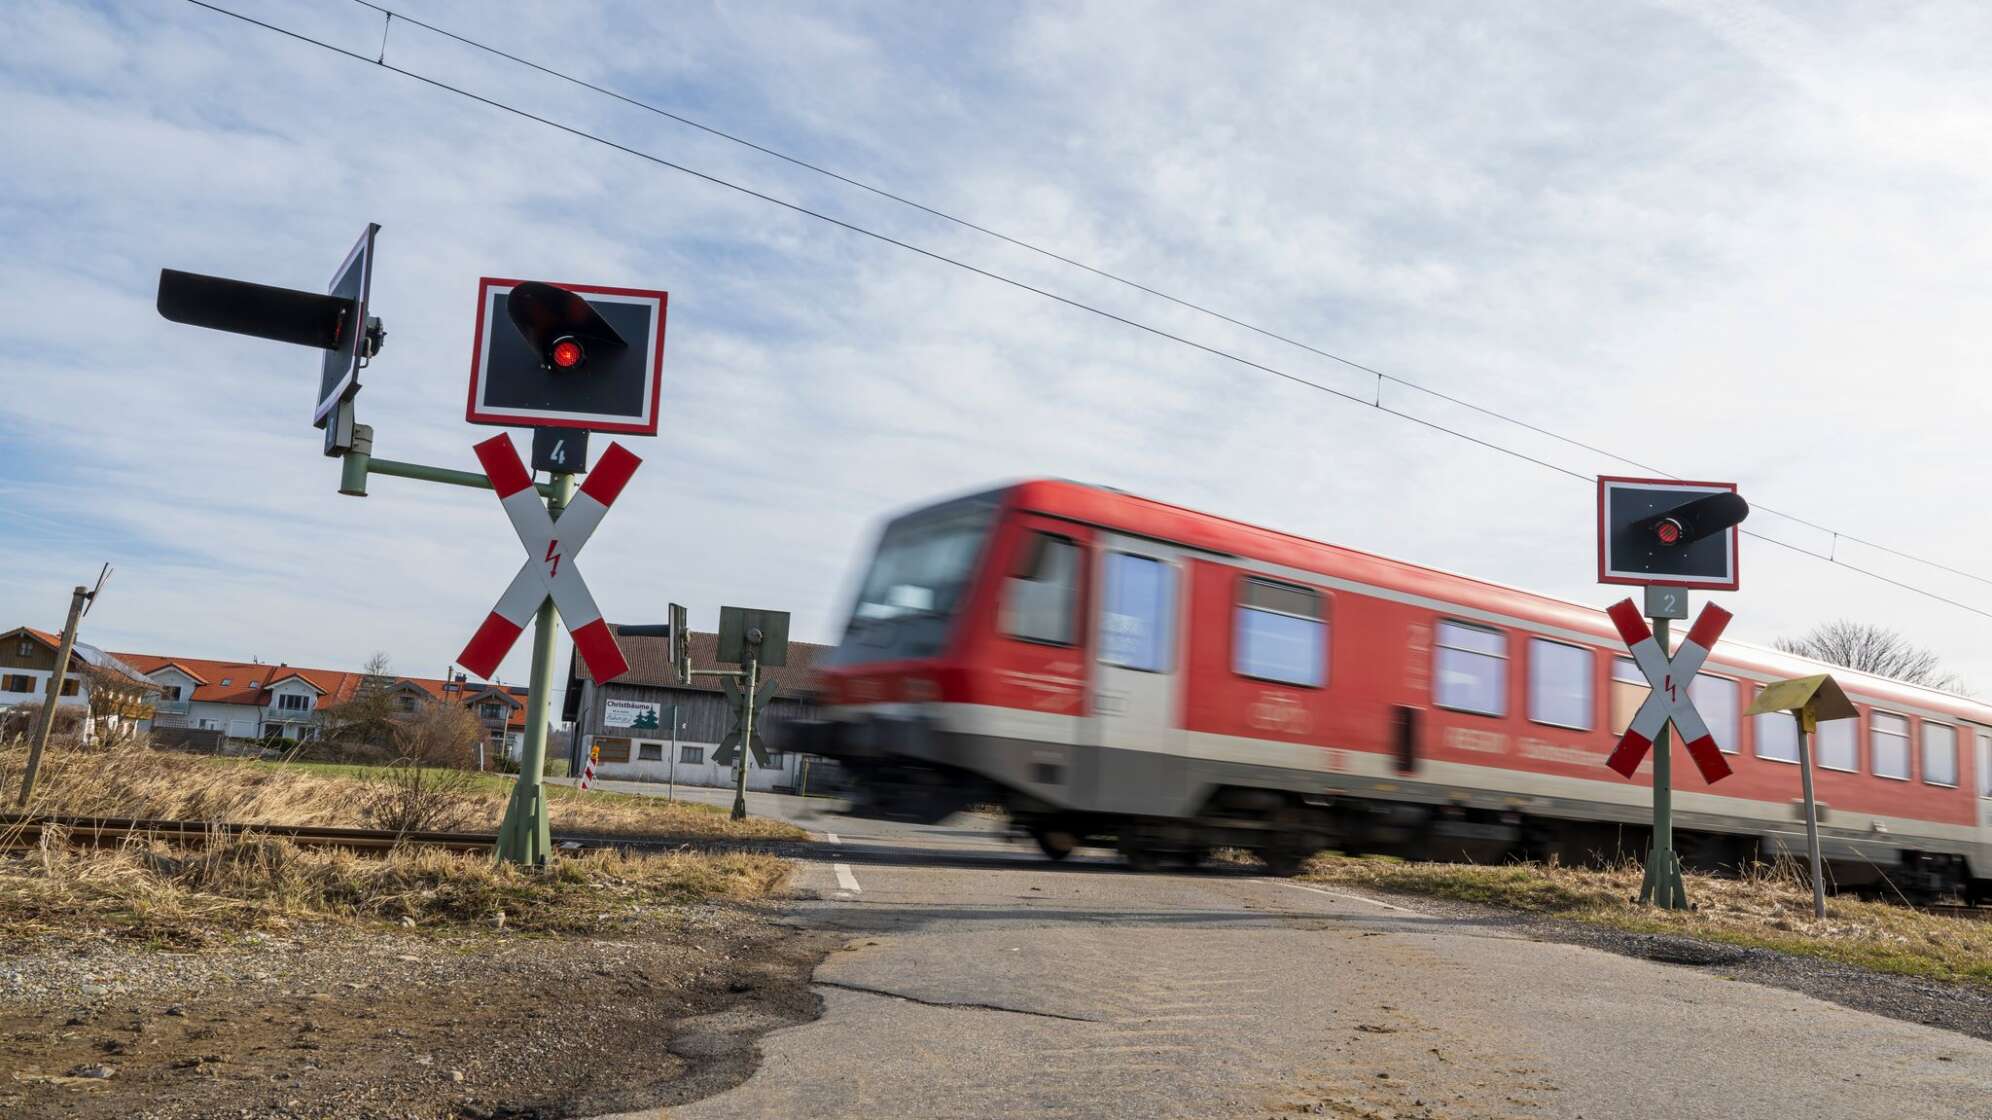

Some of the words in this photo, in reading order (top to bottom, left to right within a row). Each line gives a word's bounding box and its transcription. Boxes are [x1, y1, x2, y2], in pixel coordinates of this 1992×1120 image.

[549, 439, 566, 465] 4
[1663, 593, 1676, 613] 2
[607, 701, 650, 710] Christbäume
